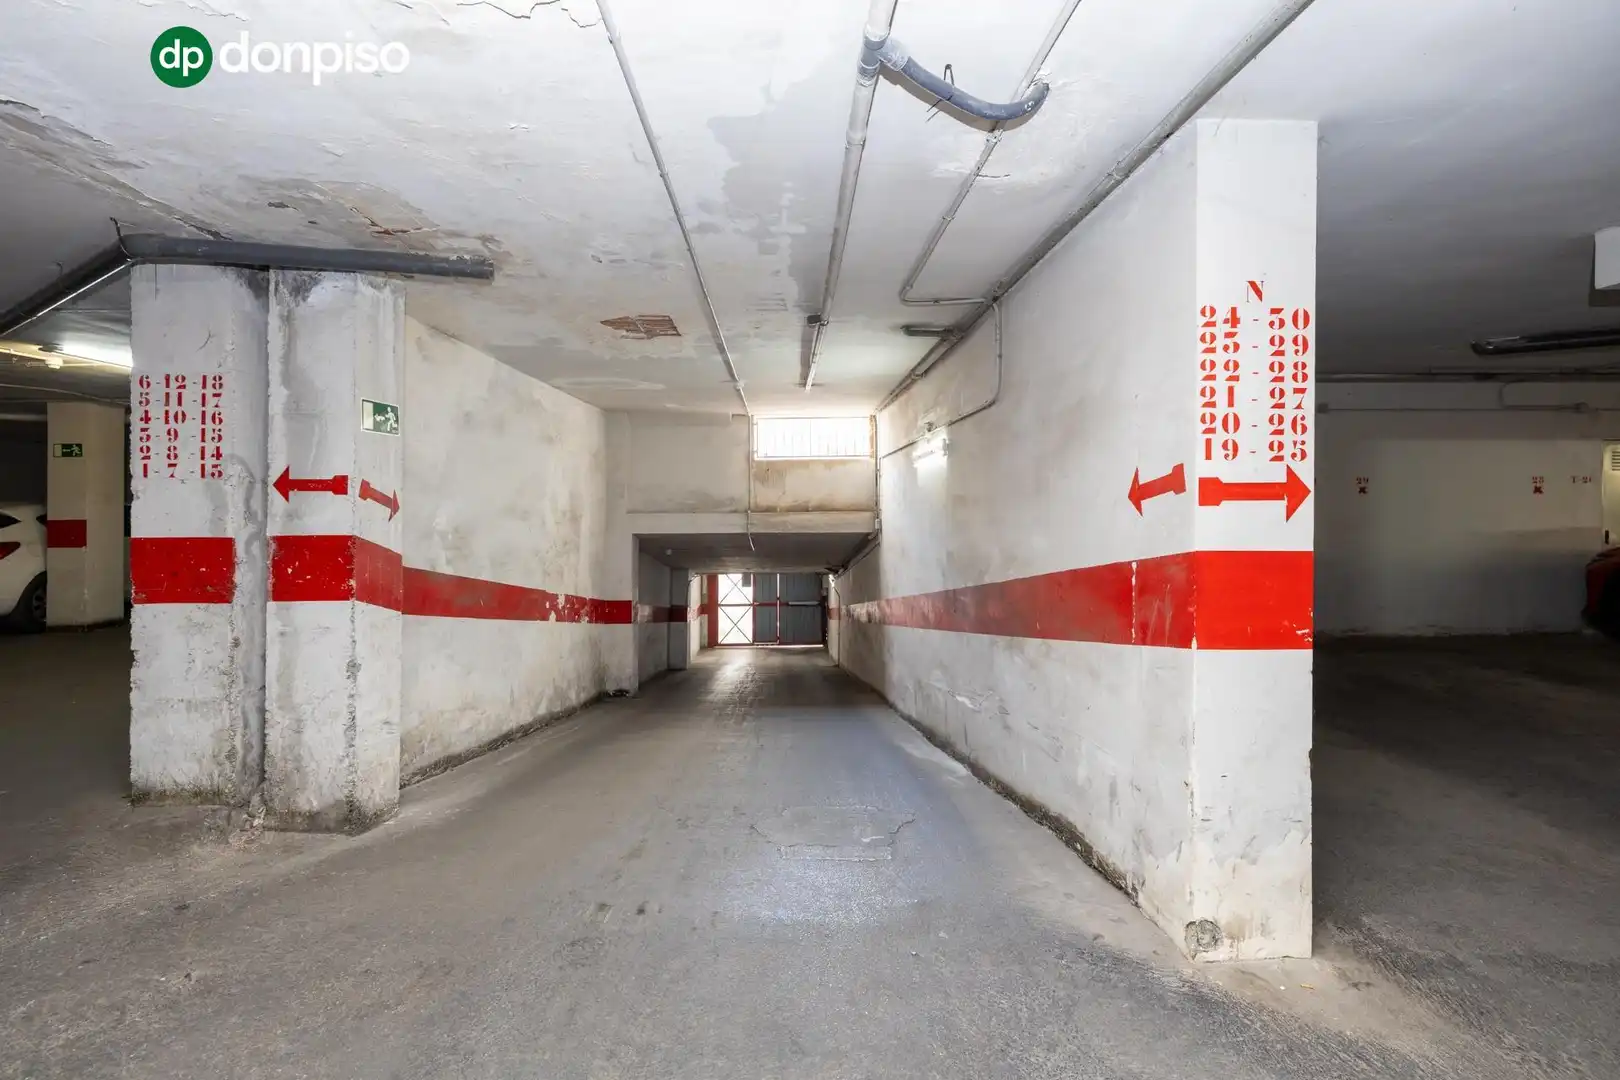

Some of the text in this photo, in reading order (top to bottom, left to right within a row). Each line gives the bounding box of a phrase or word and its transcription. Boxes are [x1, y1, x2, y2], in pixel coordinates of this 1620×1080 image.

[1246, 280, 1265, 303] N
[1199, 305, 1241, 329] 24
[1268, 334, 1309, 357] 29
[1199, 358, 1241, 382] 22
[1268, 360, 1309, 384] 28
[1199, 385, 1236, 409] 21
[1269, 386, 1308, 411] 27
[1199, 411, 1241, 435] 20
[1268, 413, 1308, 437] 26
[1204, 437, 1240, 461] 19
[1268, 439, 1309, 462] 25
